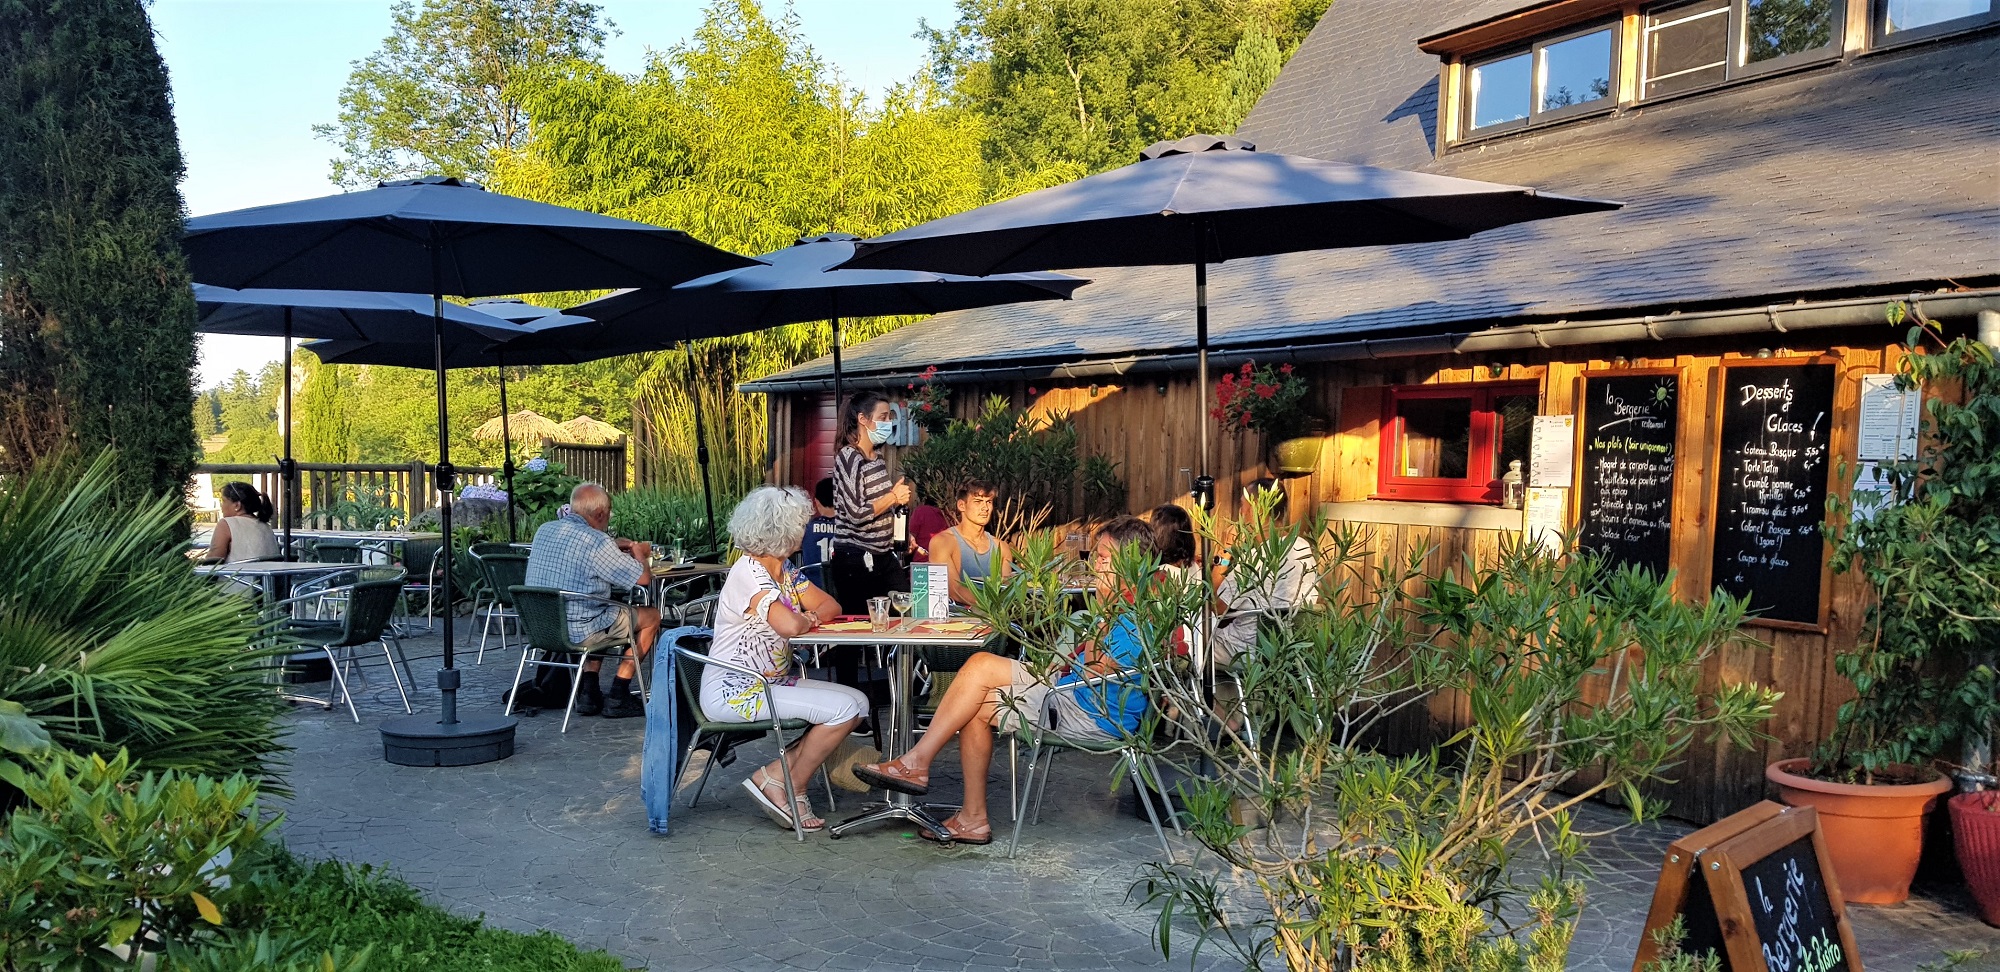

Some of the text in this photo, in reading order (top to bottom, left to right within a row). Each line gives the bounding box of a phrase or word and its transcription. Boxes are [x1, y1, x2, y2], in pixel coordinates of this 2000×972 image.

[1605, 383, 1614, 406] la
[1740, 378, 1794, 406] Desserts
[1614, 397, 1650, 421] Bergerie
[1782, 401, 1792, 412] et
[1595, 436, 1606, 449] Nos
[1607, 435, 1623, 454] plats
[1769, 441, 1797, 461] Basque
[1620, 459, 1627, 470] de
[1744, 459, 1760, 473] Tarte
[1762, 459, 1779, 474] Tatin
[1630, 475, 1637, 486] de
[1743, 474, 1769, 488] Crumble
[1626, 500, 1634, 510] du
[1635, 503, 1648, 515] pays
[1741, 502, 1769, 516] Tiramisu
[1740, 520, 1764, 533] Colonel
[1767, 521, 1791, 535] Basque
[1738, 550, 1789, 570] Coupes de glaces
[1735, 571, 1744, 582] etc
[1762, 858, 1804, 972] Bergerie
